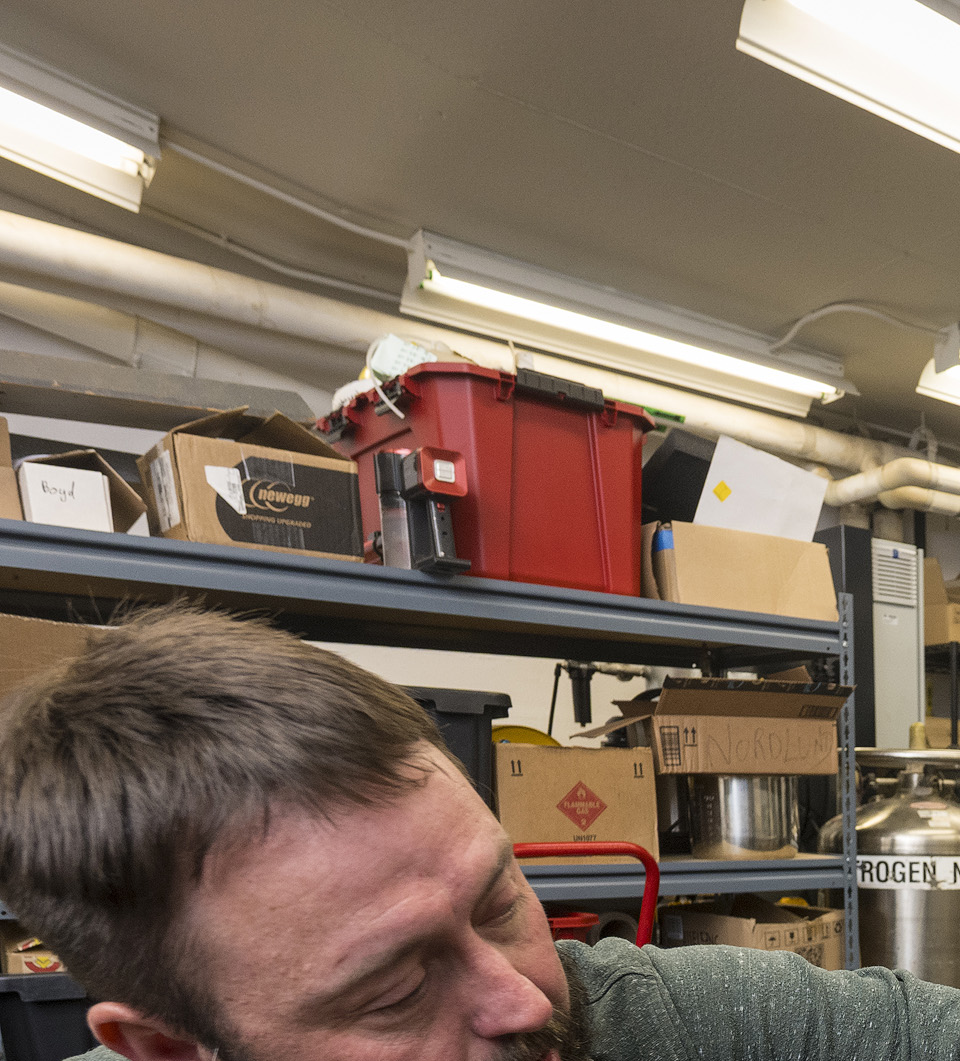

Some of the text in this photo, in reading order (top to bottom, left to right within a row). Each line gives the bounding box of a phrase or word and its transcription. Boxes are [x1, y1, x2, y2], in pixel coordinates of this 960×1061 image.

[41, 480, 76, 502] Boyd
[258, 488, 311, 508] newegg
[857, 860, 936, 883] ROGEN
